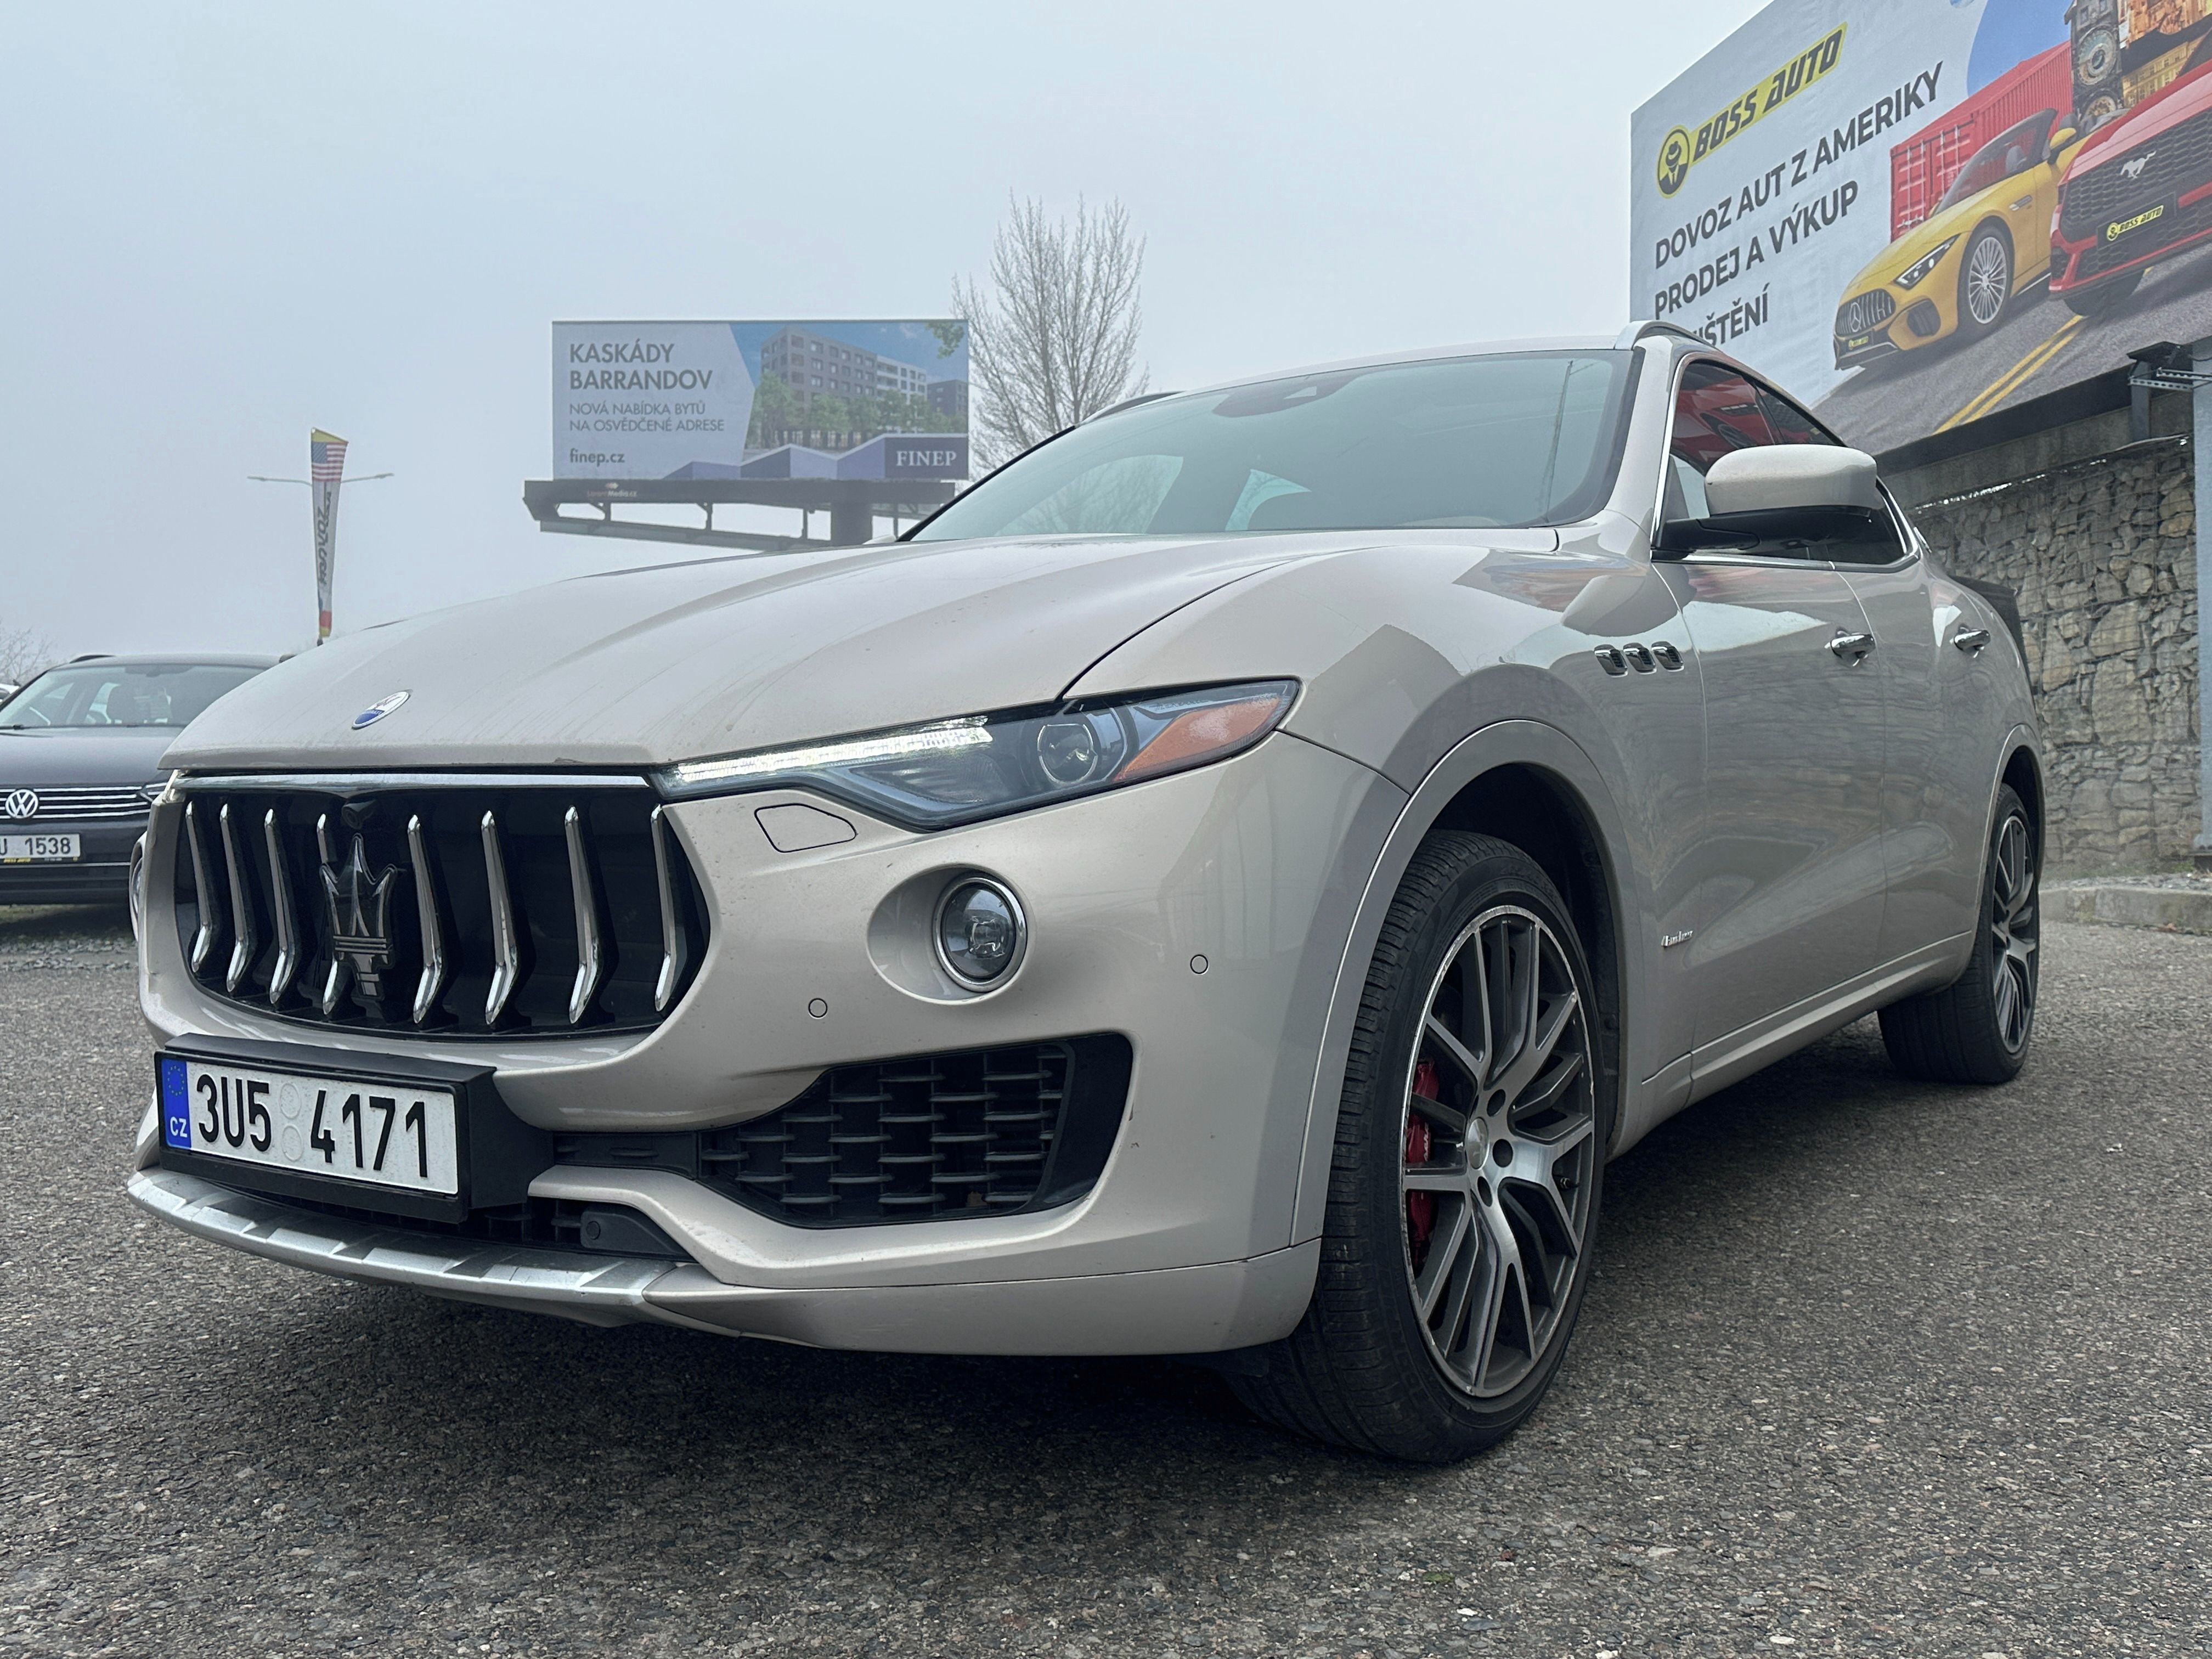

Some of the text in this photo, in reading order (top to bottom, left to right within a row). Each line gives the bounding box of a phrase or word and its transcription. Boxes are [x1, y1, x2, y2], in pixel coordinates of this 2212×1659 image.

[1693, 29, 1842, 162] BOSS AUTO
[1656, 61, 1943, 269] DOVOZ AUT Z AMERIKY
[1656, 180, 1858, 320] PRODEJ A VÝKUP
[1693, 283, 1770, 347] ŠTĚNÍ
[570, 338, 674, 363] KASKÁDY
[570, 370, 713, 390] BARRANDOV
[569, 399, 706, 415] NOVÁ NABÍDKA BYTŮ
[569, 417, 724, 432] NA OSVĚDČENÉ ADRESE
[570, 448, 624, 467] finep.cz
[896, 450, 957, 466] FINEP
[25, 838, 71, 855] 1538
[170, 1116, 188, 1138] CZ
[196, 1074, 428, 1178] 3U5 4171
